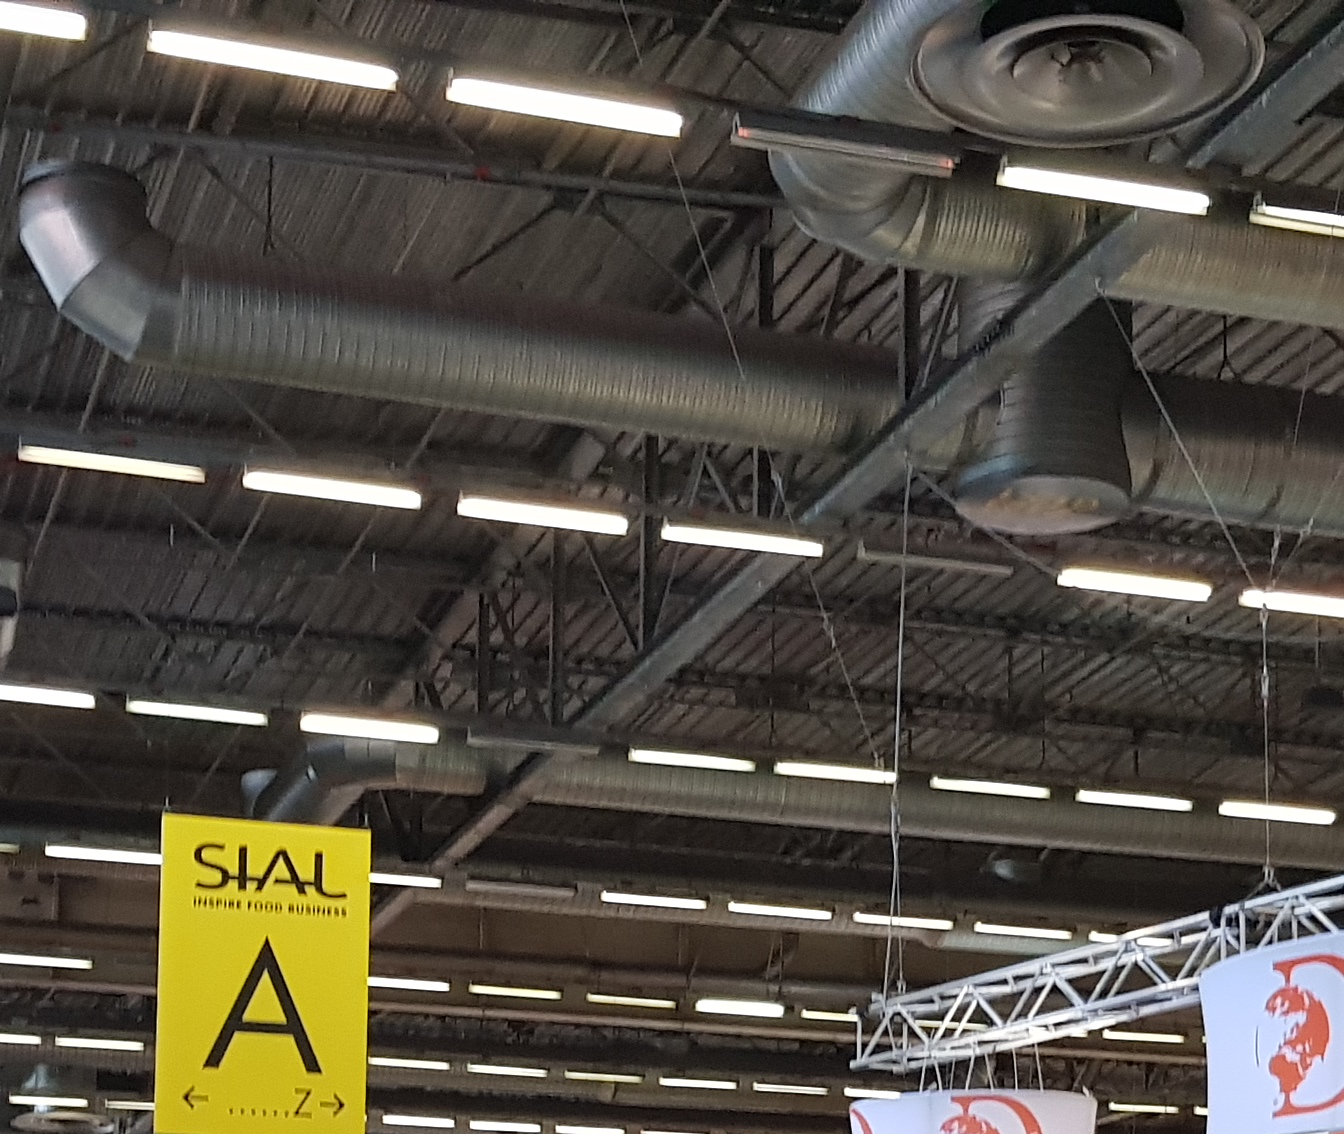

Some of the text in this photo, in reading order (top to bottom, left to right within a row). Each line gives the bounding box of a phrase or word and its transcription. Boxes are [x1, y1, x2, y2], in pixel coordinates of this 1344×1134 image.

[193, 842, 349, 899] SIAL
[192, 895, 348, 918] INSPIRE FOOD BUSINESS
[203, 935, 323, 1074] A
